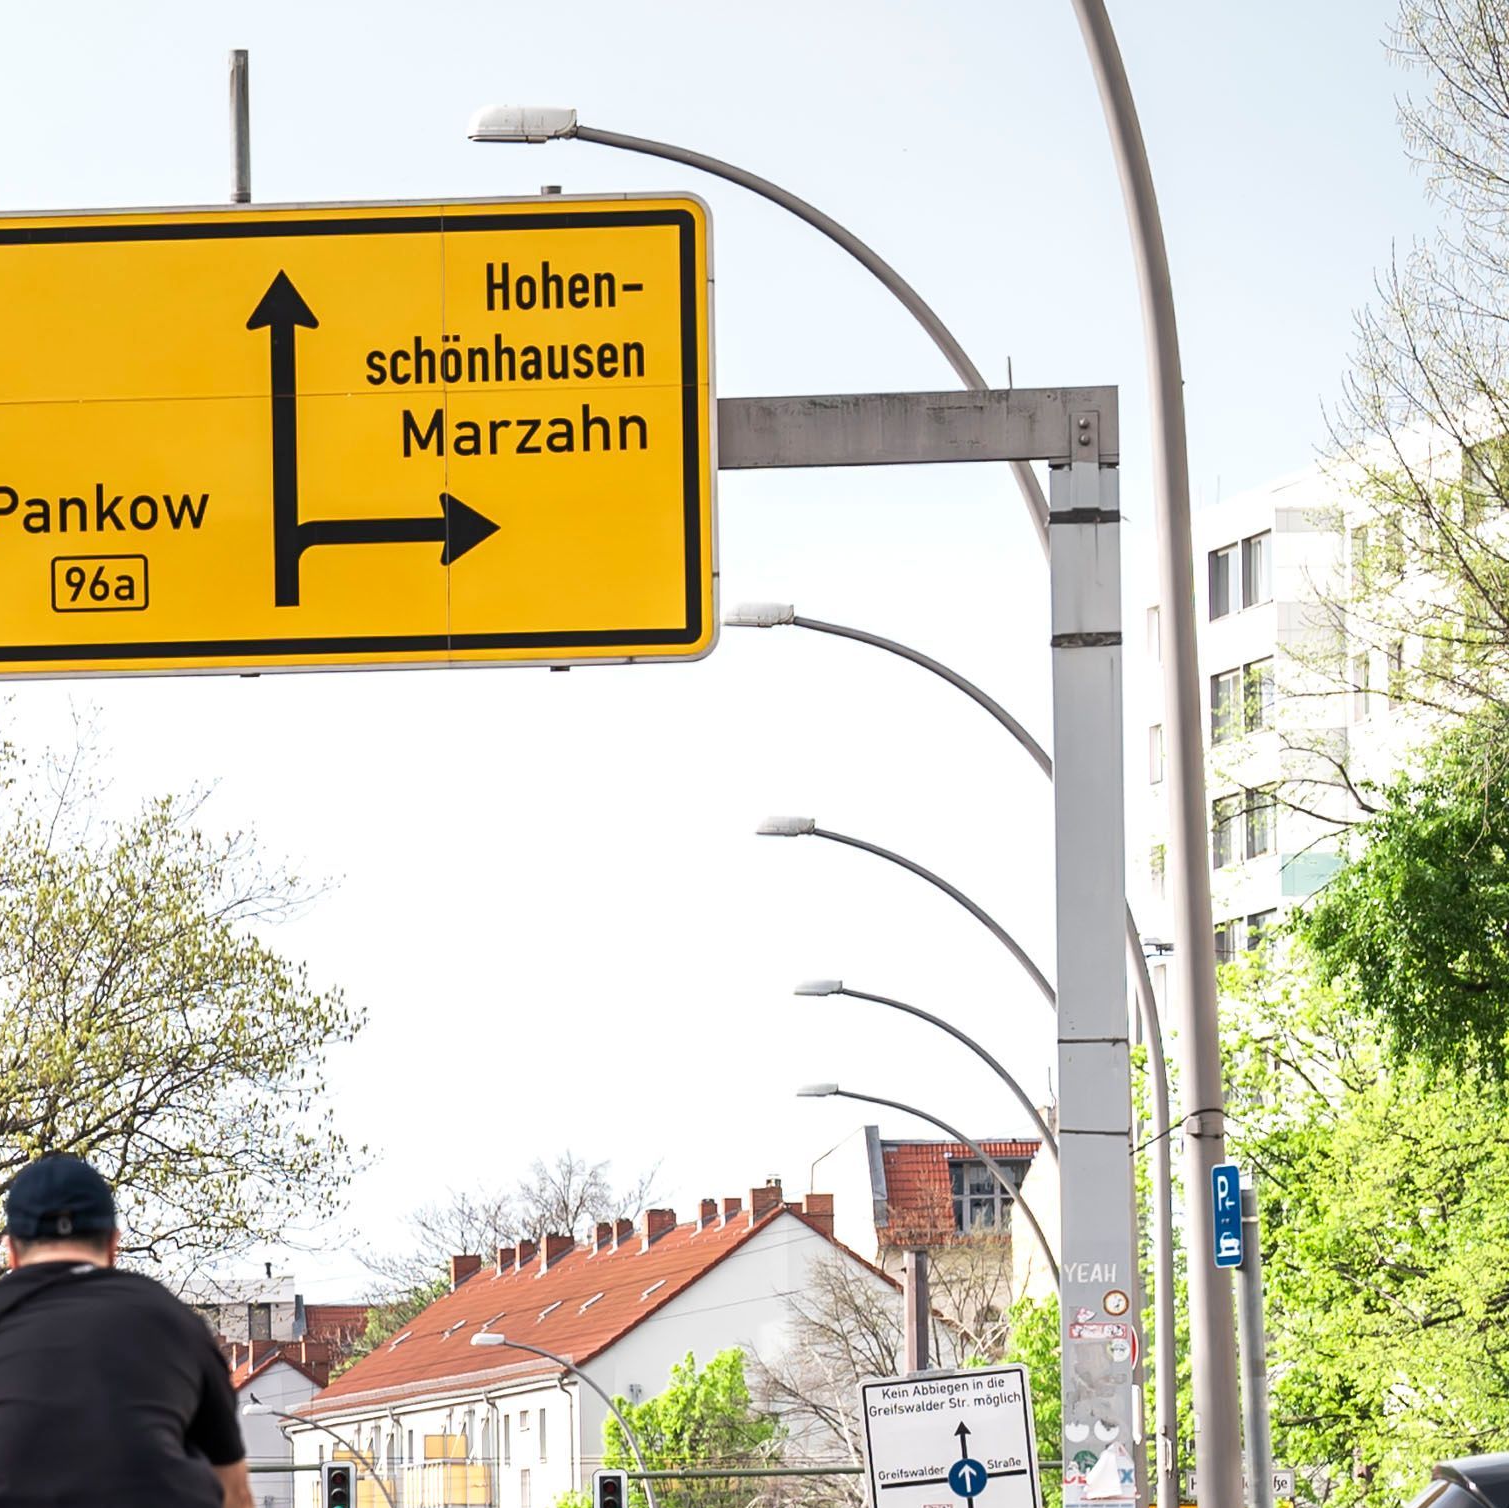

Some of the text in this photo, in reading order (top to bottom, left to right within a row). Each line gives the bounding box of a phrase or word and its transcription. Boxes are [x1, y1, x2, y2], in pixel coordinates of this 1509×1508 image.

[486, 261, 644, 312] Hohen-
[366, 333, 645, 386] schönhausen
[402, 403, 648, 458] Marzahn
[65, 565, 135, 602] 96a
[1217, 1175, 1229, 1212] P
[1063, 1262, 1117, 1283] YEAH
[869, 1391, 1022, 1418] Greifswalder Str. möglich
[882, 1377, 1006, 1400] Kein Abbiegen in die
[878, 1457, 1022, 1481] Greifswalder Straße
